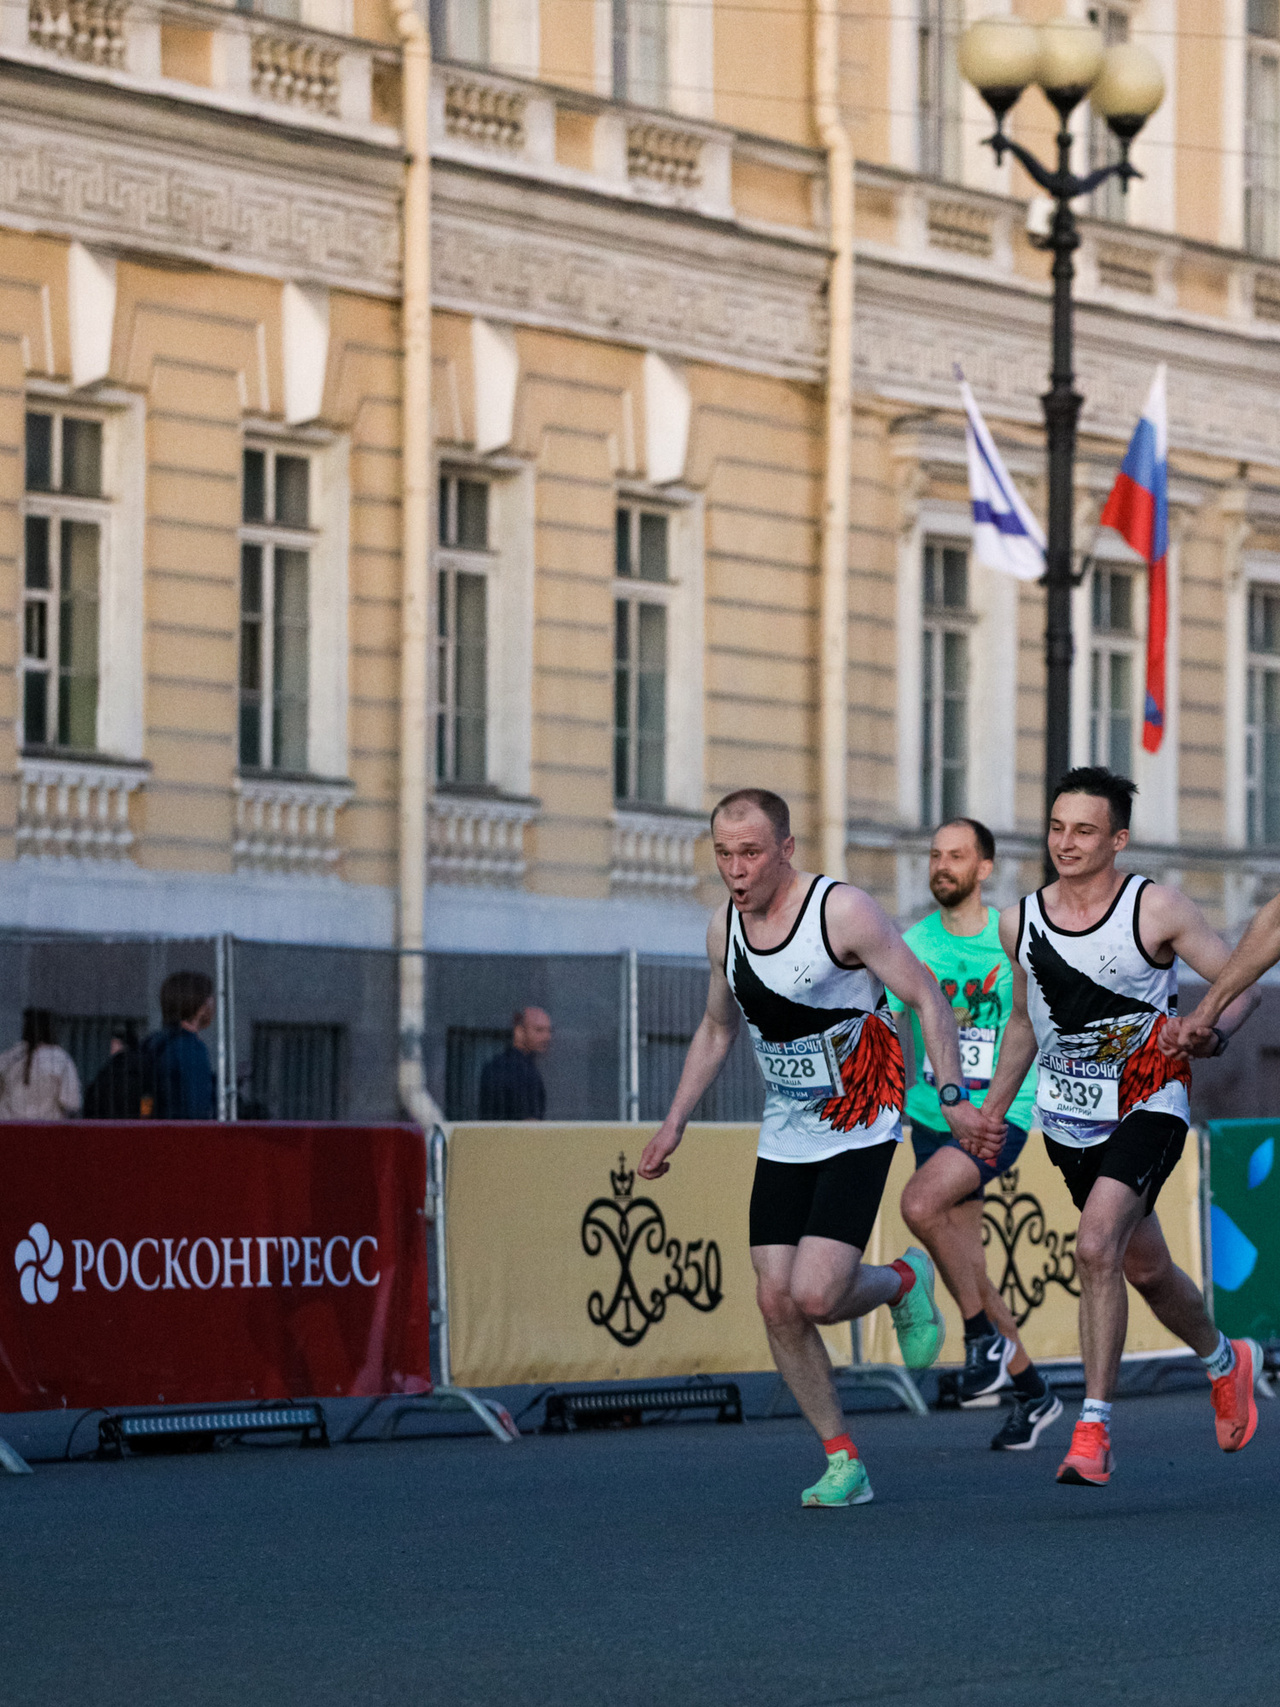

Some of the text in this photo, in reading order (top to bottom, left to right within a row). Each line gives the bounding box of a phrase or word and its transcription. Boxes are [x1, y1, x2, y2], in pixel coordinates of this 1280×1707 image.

[765, 1056, 816, 1078] 2228
[1072, 1060, 1118, 1079] НОЧИ
[1049, 1074, 1103, 1109] 3339
[1057, 1103, 1092, 1116] ДМИТРИЙ
[71, 1235, 380, 1292] РОСКОНГРЕСС
[664, 1237, 722, 1306] 350
